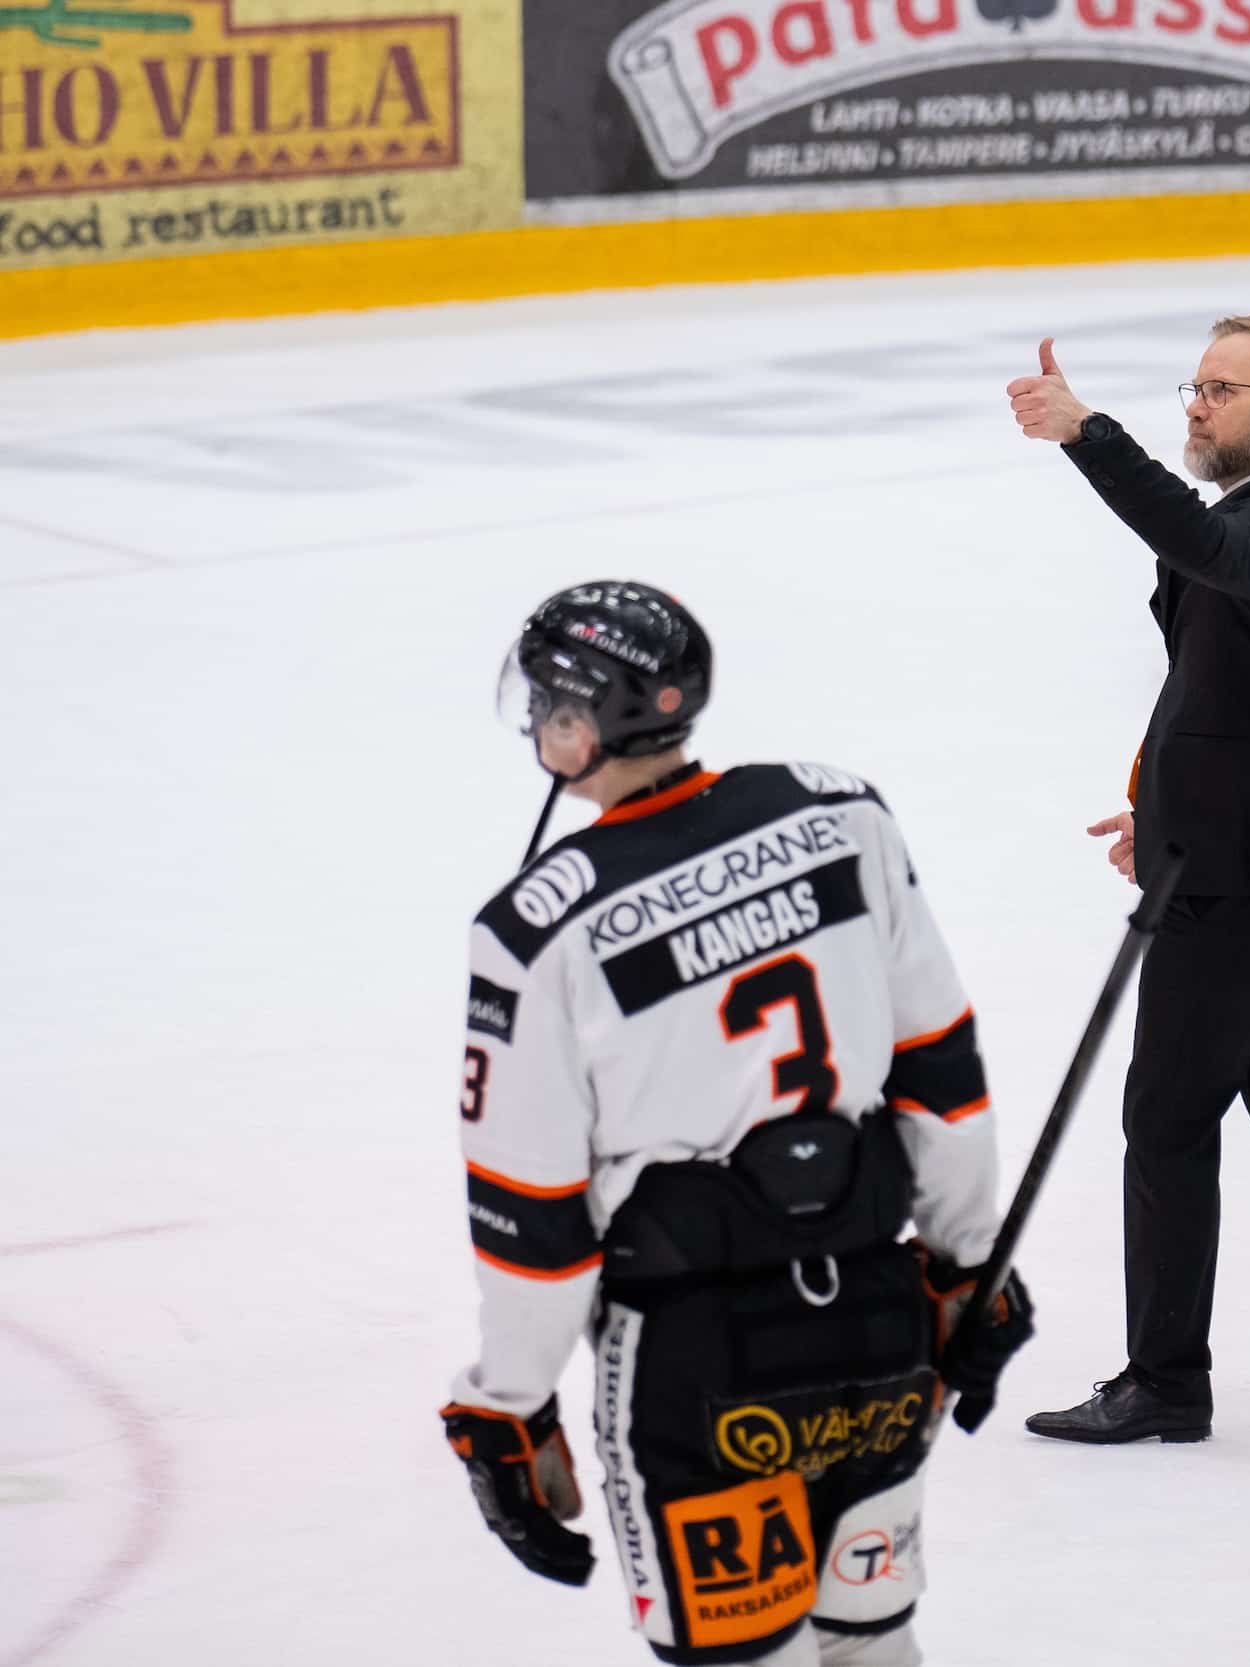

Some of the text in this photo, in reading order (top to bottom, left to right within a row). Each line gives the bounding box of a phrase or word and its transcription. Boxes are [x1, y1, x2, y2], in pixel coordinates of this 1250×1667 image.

[142, 44, 431, 140] VILLA
[810, 102, 898, 133] LAHTI
[916, 94, 1013, 128] KOTKA
[1033, 90, 1130, 122] VAASA
[747, 140, 880, 178] HELSINKI
[901, 134, 1031, 167] TAMPERE
[122, 189, 404, 247] restaurant
[668, 880, 820, 983] KANGAS
[718, 951, 840, 1114] 3
[461, 1045, 490, 1122] 3
[683, 1495, 808, 1583] RÄ
